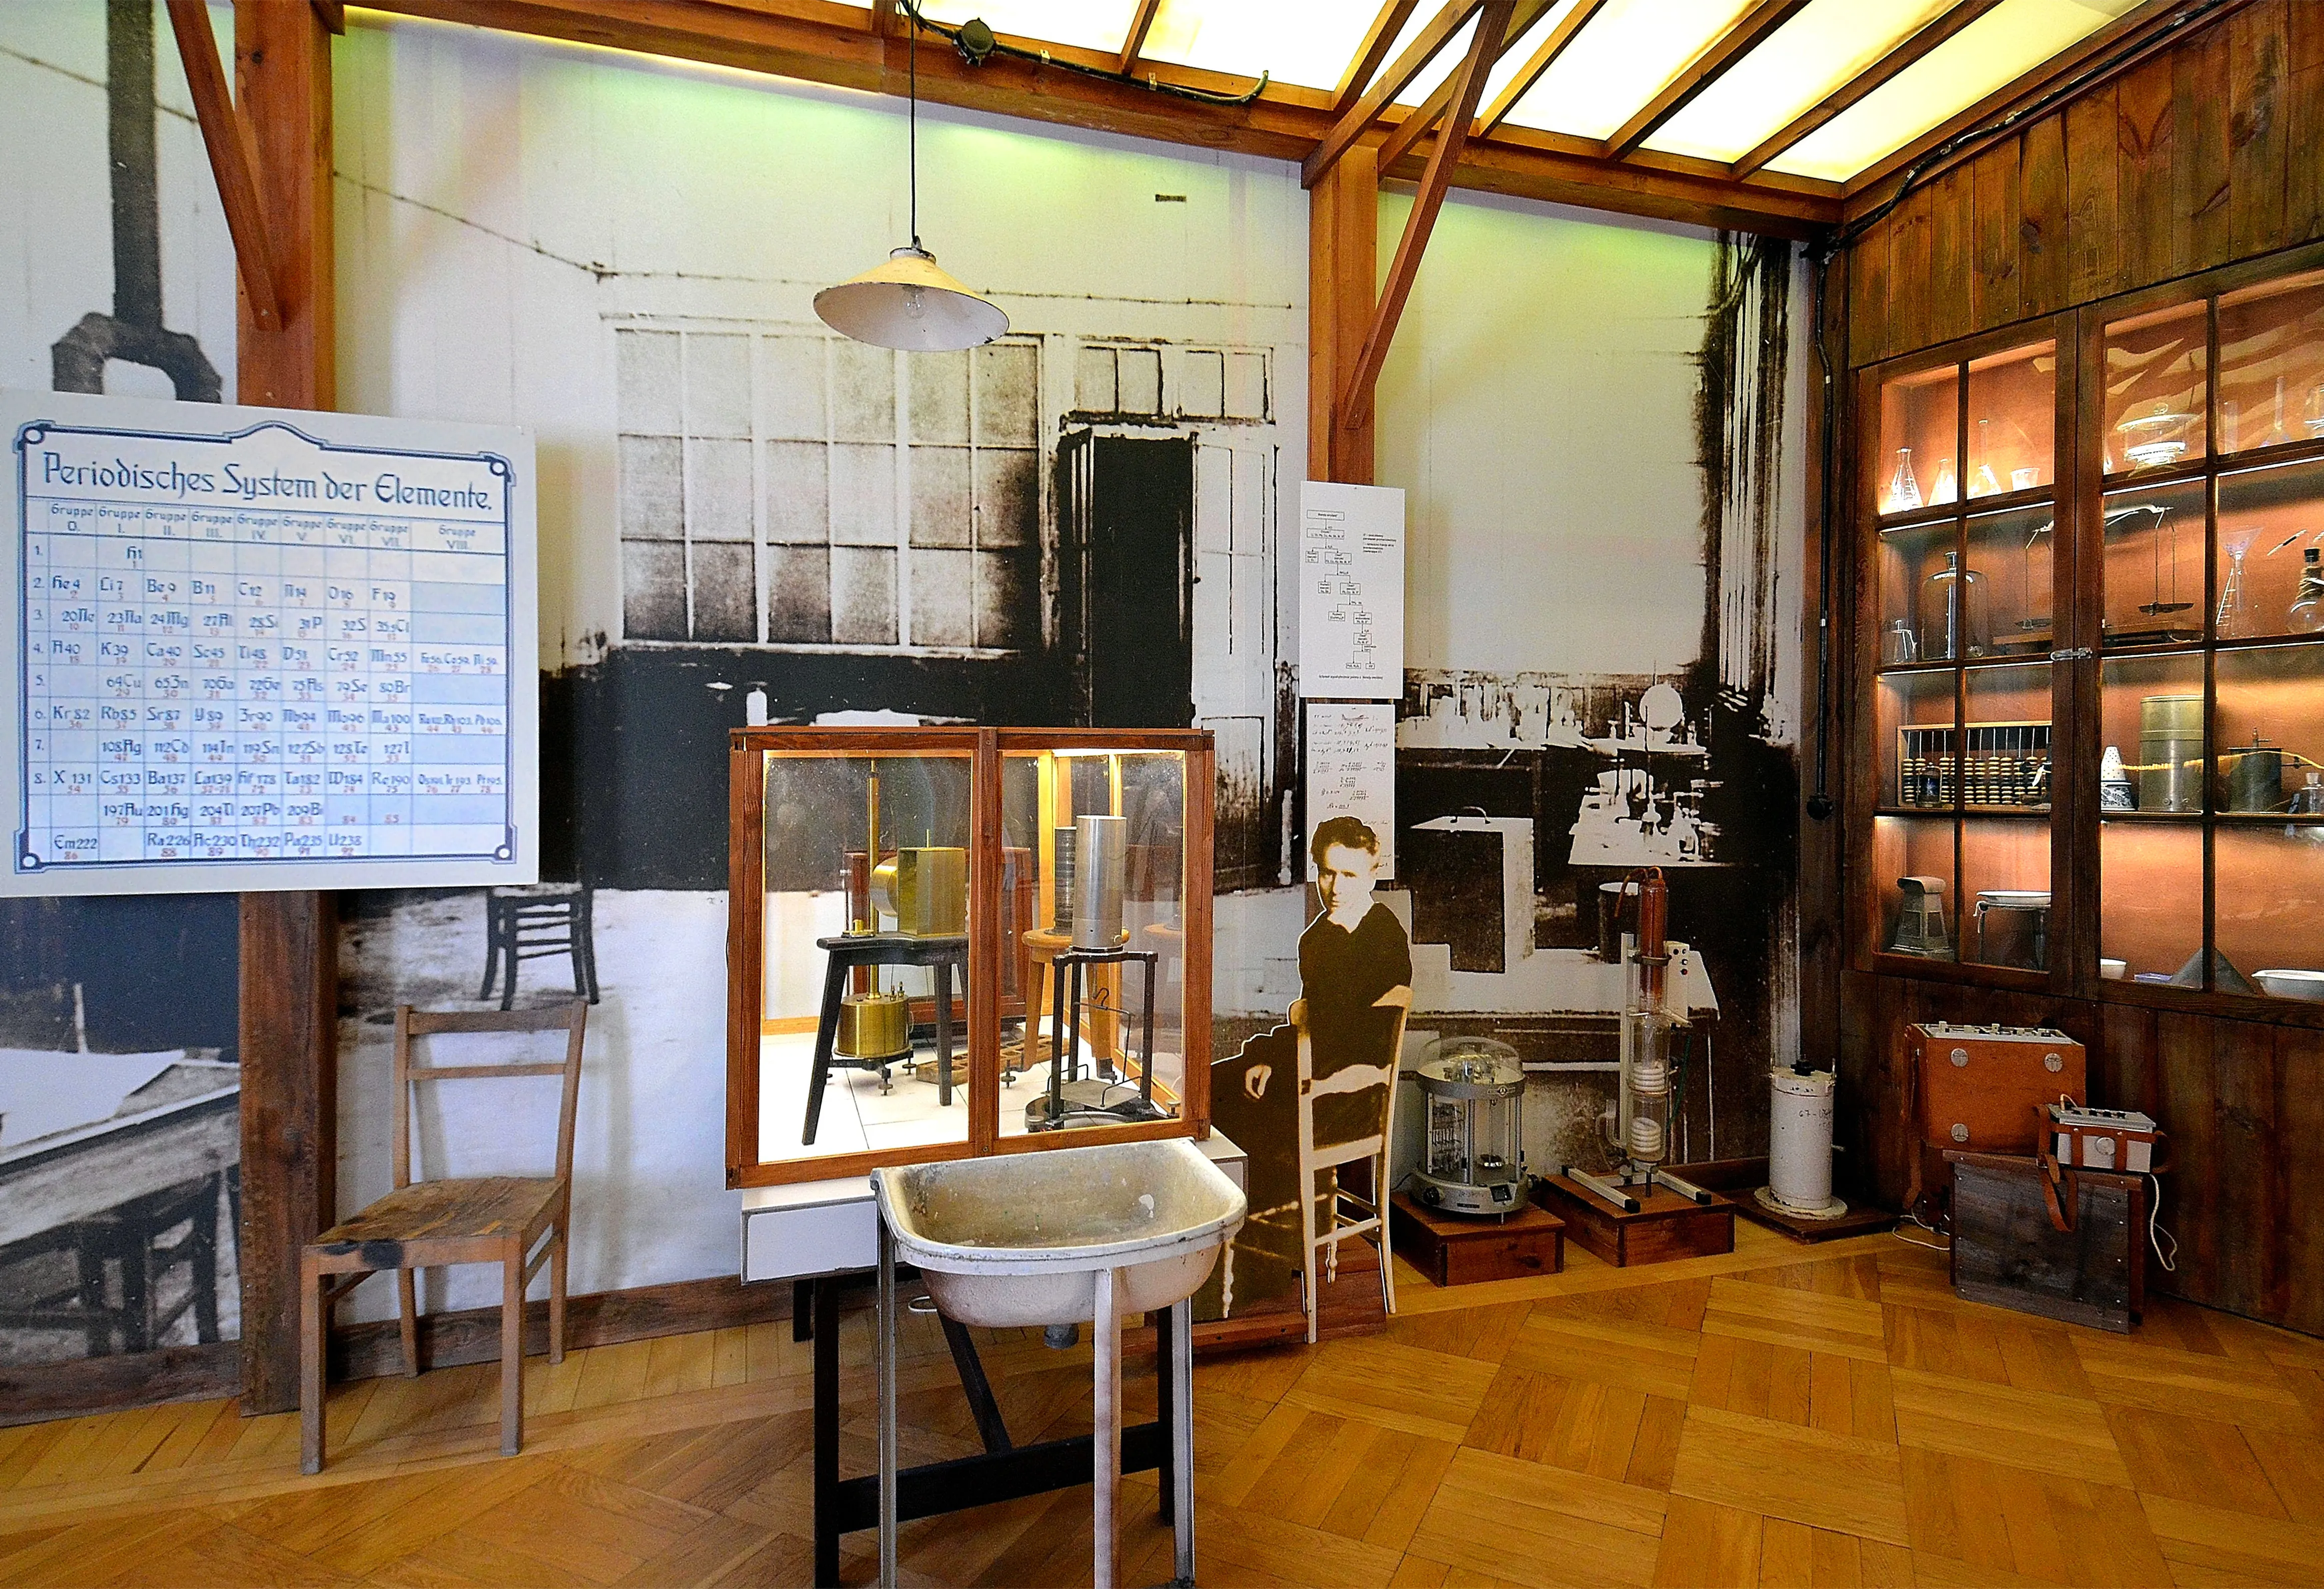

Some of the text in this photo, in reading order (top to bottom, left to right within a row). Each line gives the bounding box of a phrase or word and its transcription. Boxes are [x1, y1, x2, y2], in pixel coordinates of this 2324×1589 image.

[44, 451, 492, 510] Periodisches System der Elemente.
[52, 503, 93, 518] Gruppe
[99, 506, 141, 520] Gruppe
[146, 509, 186, 523] Gruppe
[192, 511, 232, 525] Gruppe
[54, 771, 91, 784] X 131
[100, 770, 141, 784] Cs133
